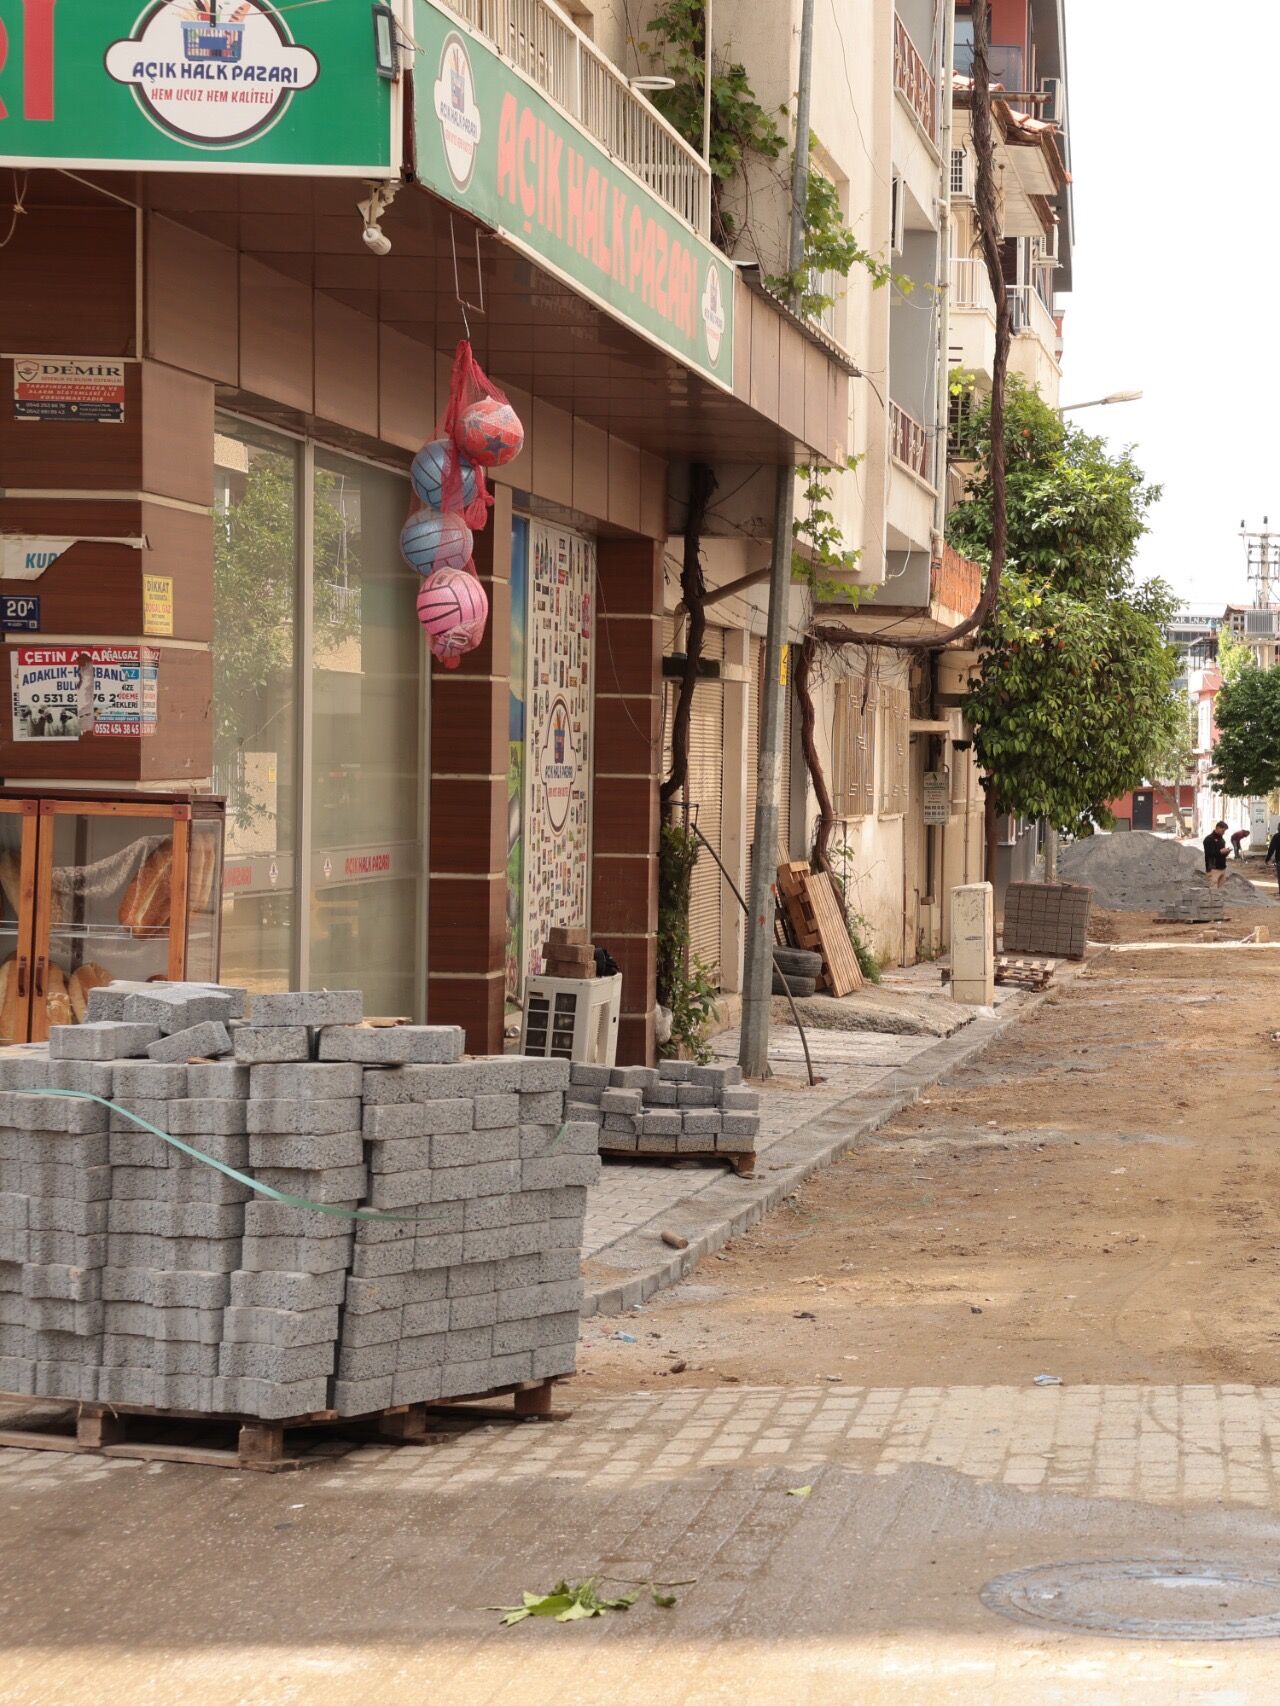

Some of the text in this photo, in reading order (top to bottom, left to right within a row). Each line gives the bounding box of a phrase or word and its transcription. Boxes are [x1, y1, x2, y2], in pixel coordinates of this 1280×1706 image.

[132, 61, 298, 84] AÇIK HALK PAZARI
[151, 88, 173, 101] HEM
[206, 90, 228, 103] HEM
[231, 88, 274, 105] KALİTELİ
[497, 91, 698, 339] AÇIK HALK PAZARI
[44, 694, 63, 703] 531
[94, 723, 111, 734] 0552
[123, 724, 131, 734] 38
